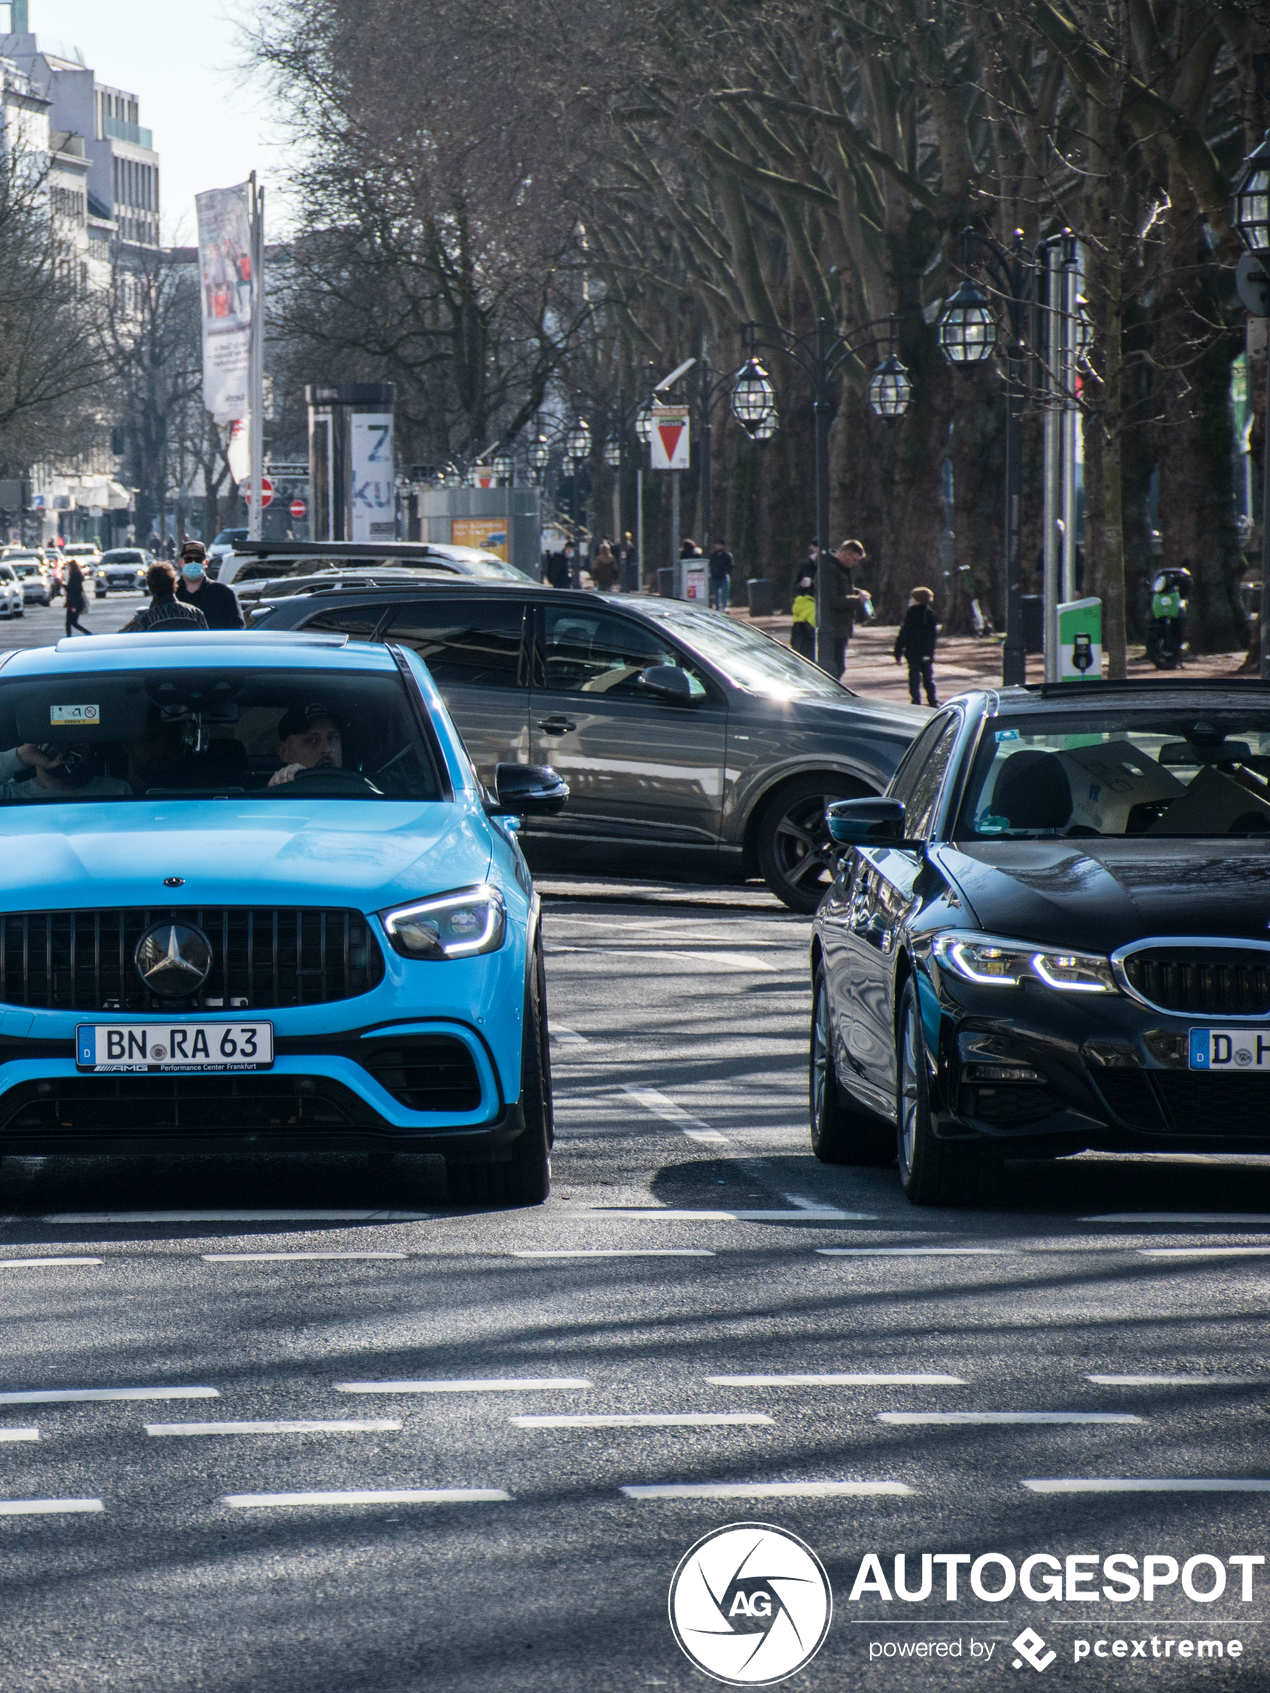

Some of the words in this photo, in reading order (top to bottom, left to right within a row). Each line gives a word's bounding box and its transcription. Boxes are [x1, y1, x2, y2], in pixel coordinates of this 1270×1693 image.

[107, 1030, 147, 1059] BN
[170, 1029, 210, 1058] RA
[219, 1028, 258, 1057] 63
[83, 1049, 91, 1058] D
[1211, 1034, 1232, 1064] D
[1196, 1053, 1205, 1062] D
[110, 1064, 149, 1072] AMG
